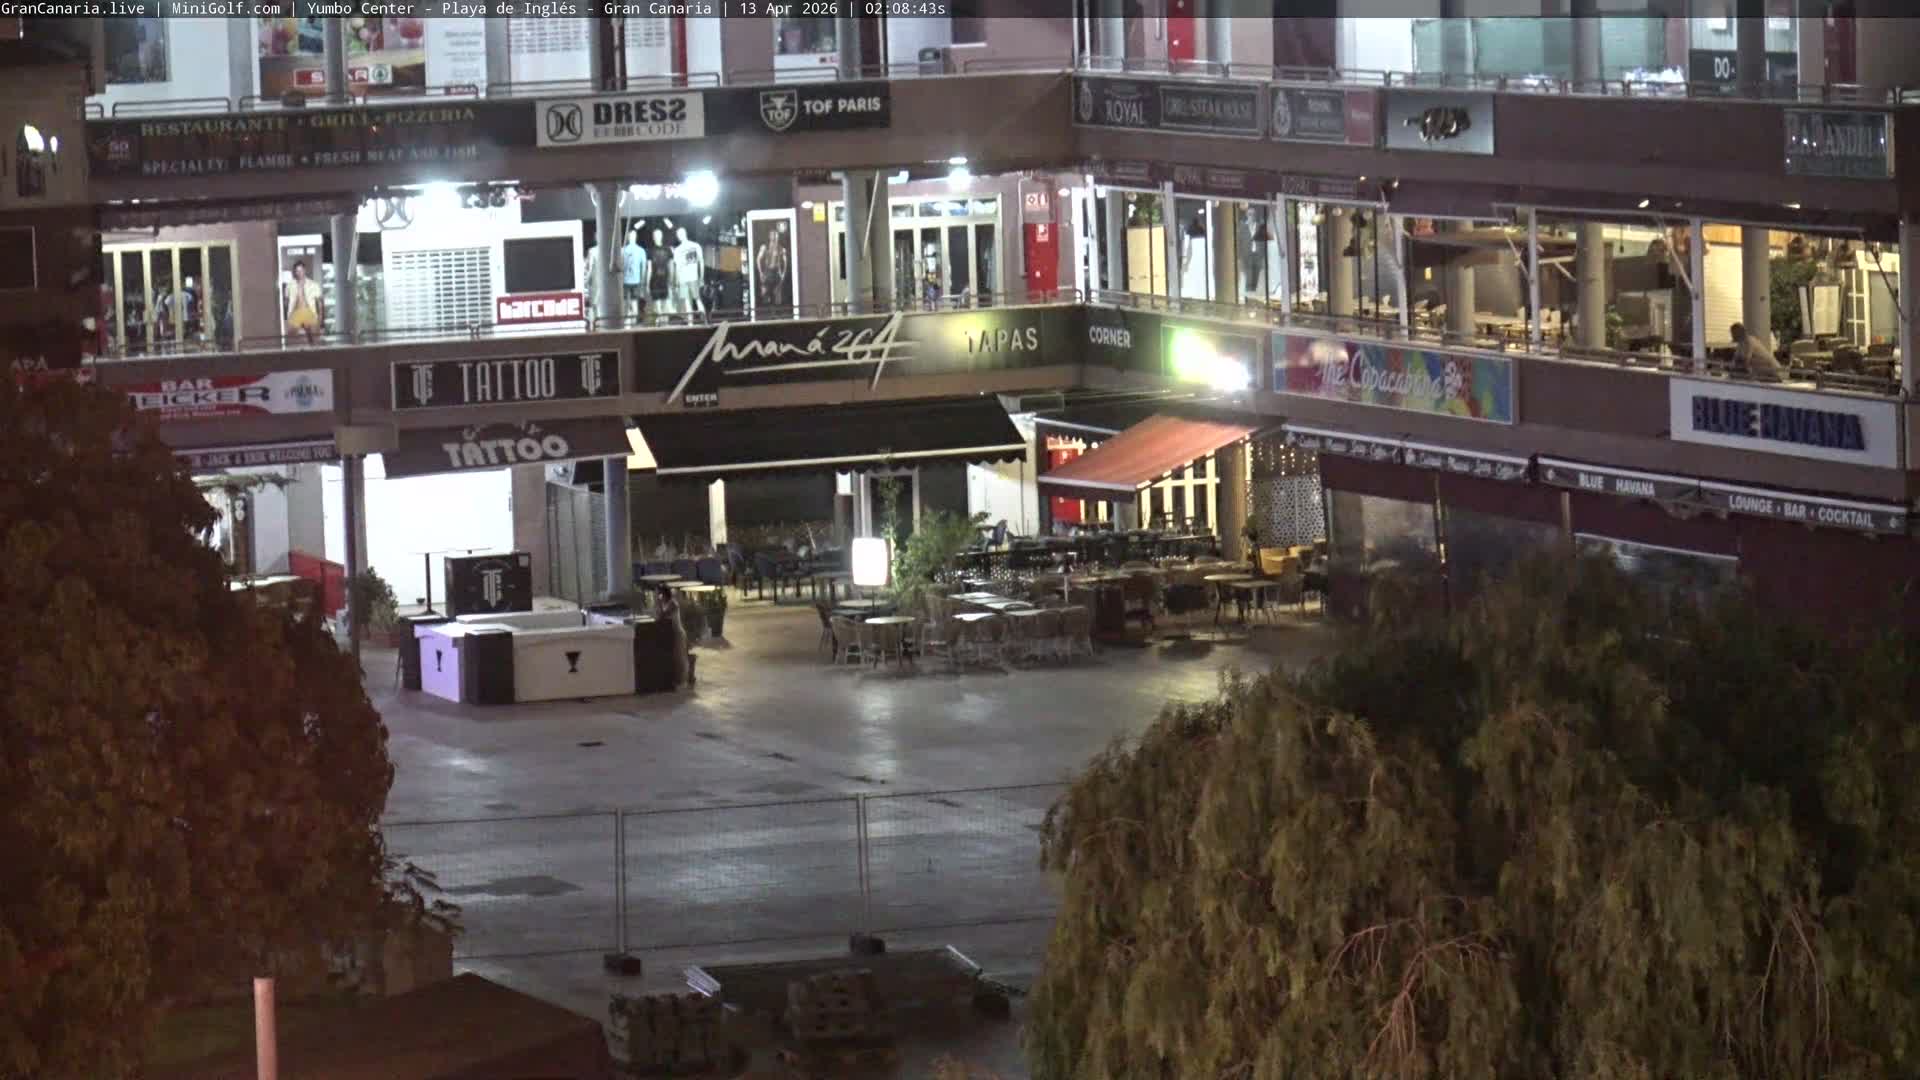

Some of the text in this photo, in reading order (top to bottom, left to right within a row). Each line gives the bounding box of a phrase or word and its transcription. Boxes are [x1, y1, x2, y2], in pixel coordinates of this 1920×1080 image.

[593, 98, 686, 125] DRESS
[767, 109, 791, 121] TOF
[803, 96, 881, 115] TOF PARIS
[1105, 100, 1145, 125] ROYAL
[141, 107, 475, 136] RESTAURANTE GRILL PIZZERIA
[314, 150, 361, 164] FRESH
[1089, 326, 1131, 348] CORNER
[161, 378, 214, 394] BAR
[458, 358, 556, 403] TATTOO
[1692, 396, 1866, 450] BLUE HAVANA
[442, 434, 569, 468] TATTOO
[1579, 472, 1655, 496] BLUE HAVANA
[1729, 495, 1875, 529] LOUNGE BAR COCKTAIL
